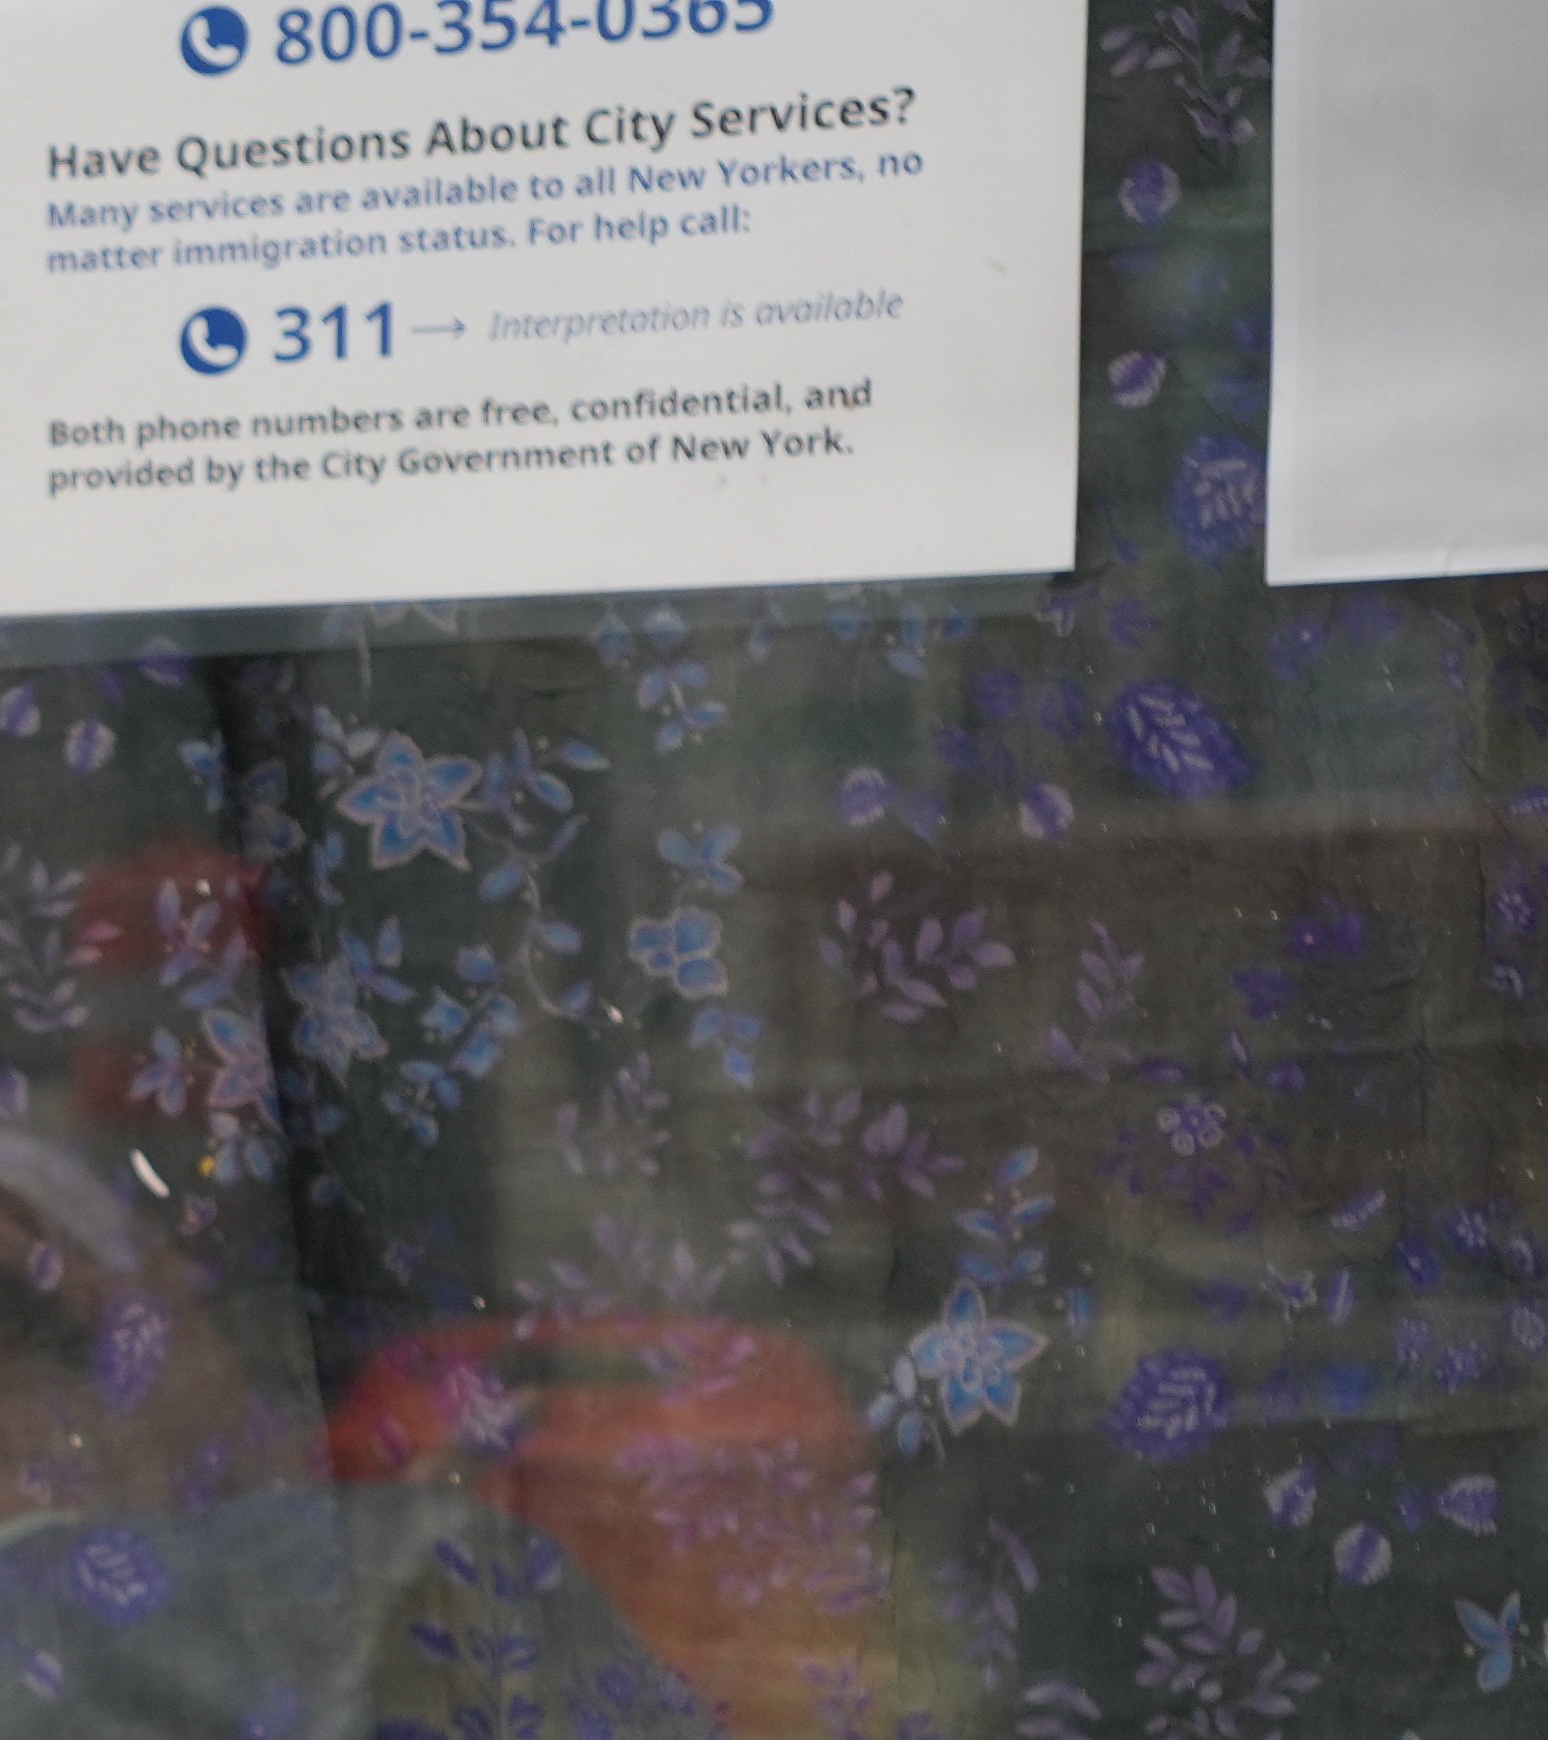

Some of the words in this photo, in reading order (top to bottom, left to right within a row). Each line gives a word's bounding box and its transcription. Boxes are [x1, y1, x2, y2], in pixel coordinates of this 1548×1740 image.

[274, 0, 775, 67] 800-354-0365
[48, 144, 161, 180] Have
[175, 126, 410, 177] Questions
[425, 115, 568, 156] About
[584, 106, 676, 148] City
[691, 86, 916, 139] Services?
[46, 201, 139, 234] Many
[148, 190, 285, 224] services
[294, 189, 351, 215] are
[360, 173, 518, 211] available
[528, 175, 564, 201] to
[574, 166, 615, 198] all
[628, 165, 706, 193] New
[717, 156, 865, 188] Yorkers,
[878, 152, 923, 177] no
[45, 245, 164, 273] matter
[171, 229, 388, 270] immigration
[397, 225, 516, 255] status.
[526, 217, 584, 246] For
[592, 210, 670, 247] help
[678, 204, 751, 237] call:
[273, 301, 394, 364] 311
[487, 303, 711, 342] Interpretation
[718, 297, 746, 329] is
[753, 288, 904, 327] available
[47, 417, 126, 448] Both
[134, 414, 242, 448] phone
[249, 406, 405, 438] numbers
[412, 406, 471, 431] are
[480, 397, 559, 427] free,
[569, 382, 792, 423] confidential,
[804, 378, 872, 410] and
[47, 456, 195, 499] provided
[205, 456, 245, 492] by
[254, 453, 311, 483] the
[320, 450, 387, 486] City
[396, 440, 615, 476] Government
[625, 434, 661, 465] of
[671, 434, 750, 462] New
[760, 426, 853, 458] York.
